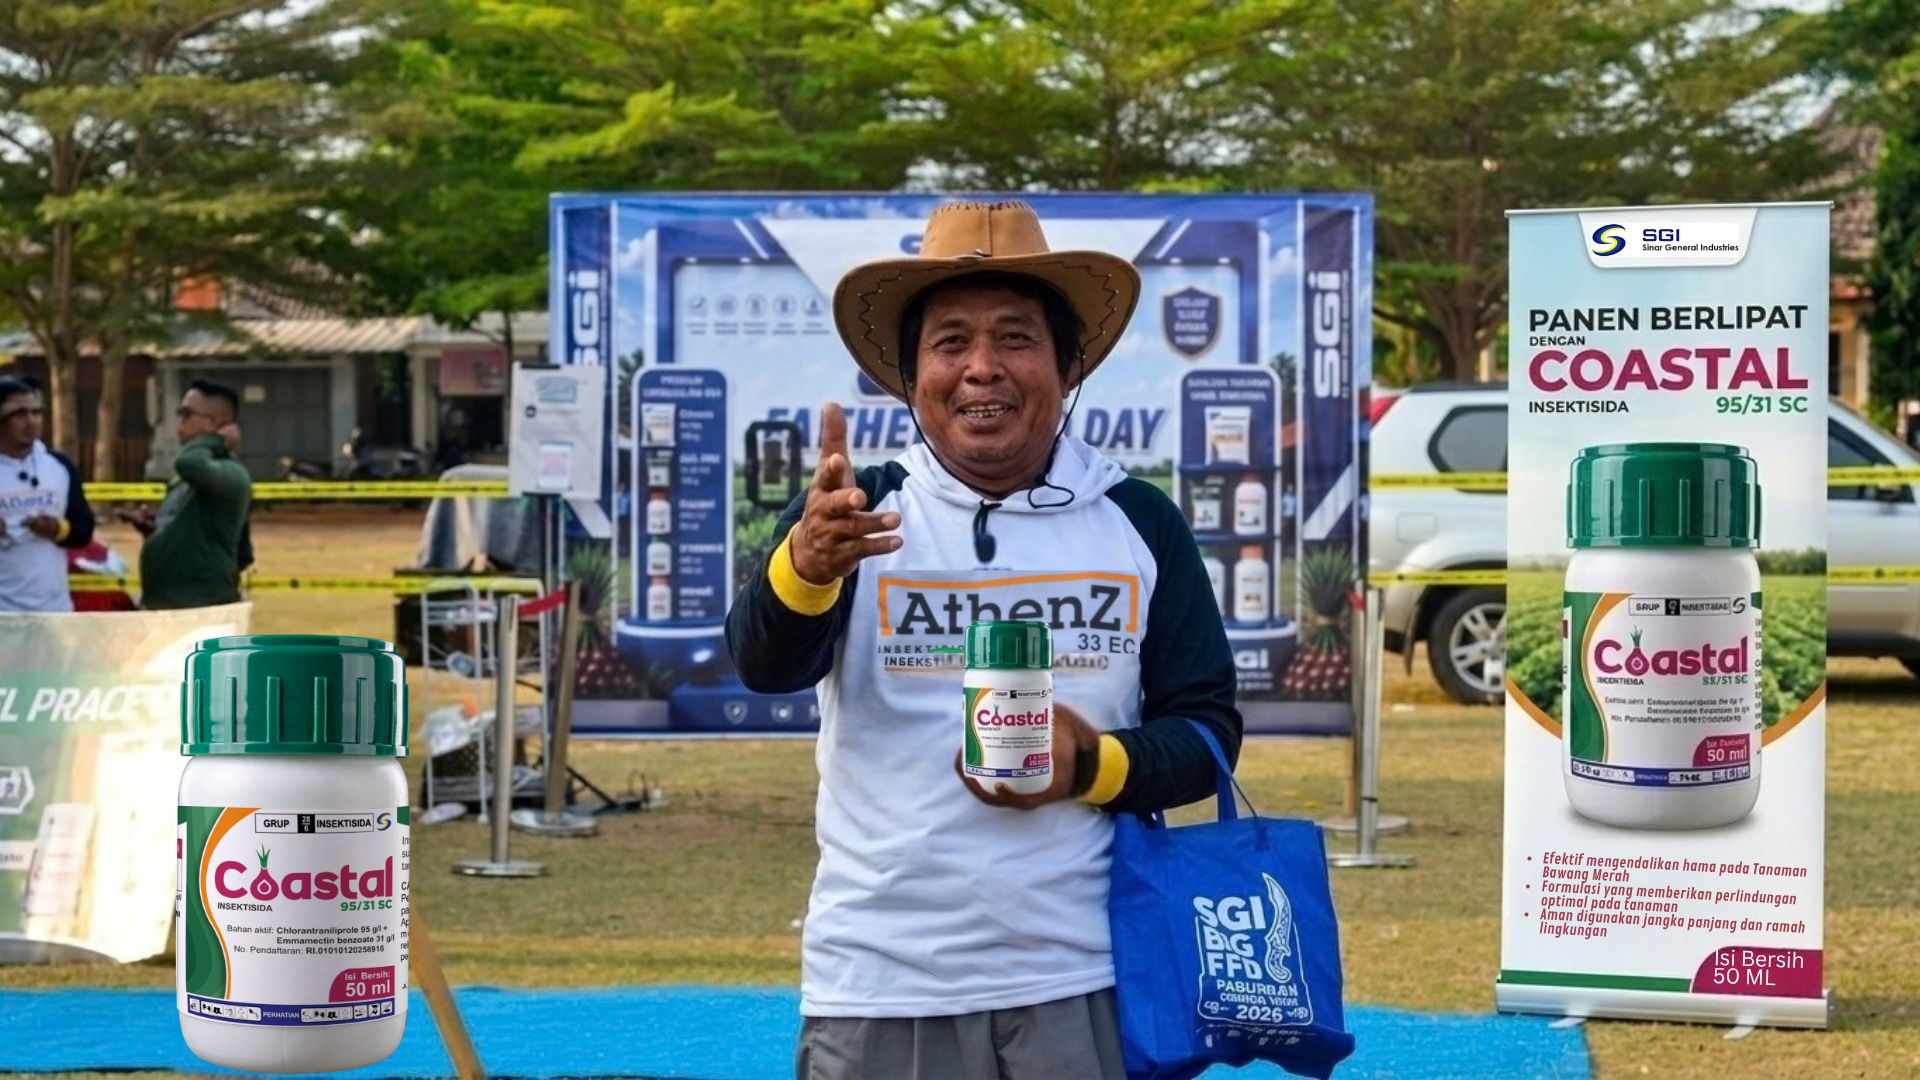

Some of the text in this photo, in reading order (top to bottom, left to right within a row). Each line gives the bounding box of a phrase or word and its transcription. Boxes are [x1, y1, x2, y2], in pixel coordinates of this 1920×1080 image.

[1642, 228, 1680, 242] SGI
[1642, 243, 1739, 252] Sinar General Industries
[1529, 305, 1808, 332] PANEN BERLIPAT
[1529, 347, 1808, 392] COASTAL
[1529, 395, 1808, 415] INSEKTISIDA 95/31 SC
[1083, 408, 1165, 450] DAY
[896, 584, 1121, 635] AthenZ
[1078, 633, 1136, 654] 33 EC
[1594, 636, 1749, 676] Coastal
[977, 707, 1048, 726] Coastal
[263, 818, 372, 828] GRUP INSEKTISIDA
[1543, 852, 1807, 878] Efektif mengendalikan hama pada Tanaman
[1543, 866, 1630, 883] Bawang Merah
[214, 855, 393, 901] Coastal
[1542, 880, 1797, 906] Formulasi yang memberikan perlindungan
[217, 899, 393, 912] INSEKTISIDA 95/31 SC
[1193, 896, 1266, 931] SGI
[1541, 895, 1678, 913] optimal pada tanaman
[227, 925, 252, 933] Bahan
[254, 926, 274, 934] aktif:
[276, 926, 359, 936] Chlorantraniliprole
[372, 925, 382, 934] g/l
[1539, 922, 1608, 940] lingkungan
[1540, 909, 1805, 934] Aman digunakan jangka panjang dan ramah
[276, 936, 335, 944] Emmamectin
[337, 935, 374, 944] benzoate
[386, 934, 395, 943] g/l
[1203, 925, 1254, 958] BIG
[234, 945, 385, 955] No. Pendaftaran: RI.01010120258916
[1714, 950, 1804, 969] Isi Bersih
[1206, 952, 1263, 980] FFD
[344, 971, 391, 981] Isi Bersih:
[1714, 968, 1776, 987] 50 ML
[345, 980, 390, 997] 50 ml
[263, 1011, 300, 1019] PERHATIAN
[1236, 1005, 1284, 1023] 2026
